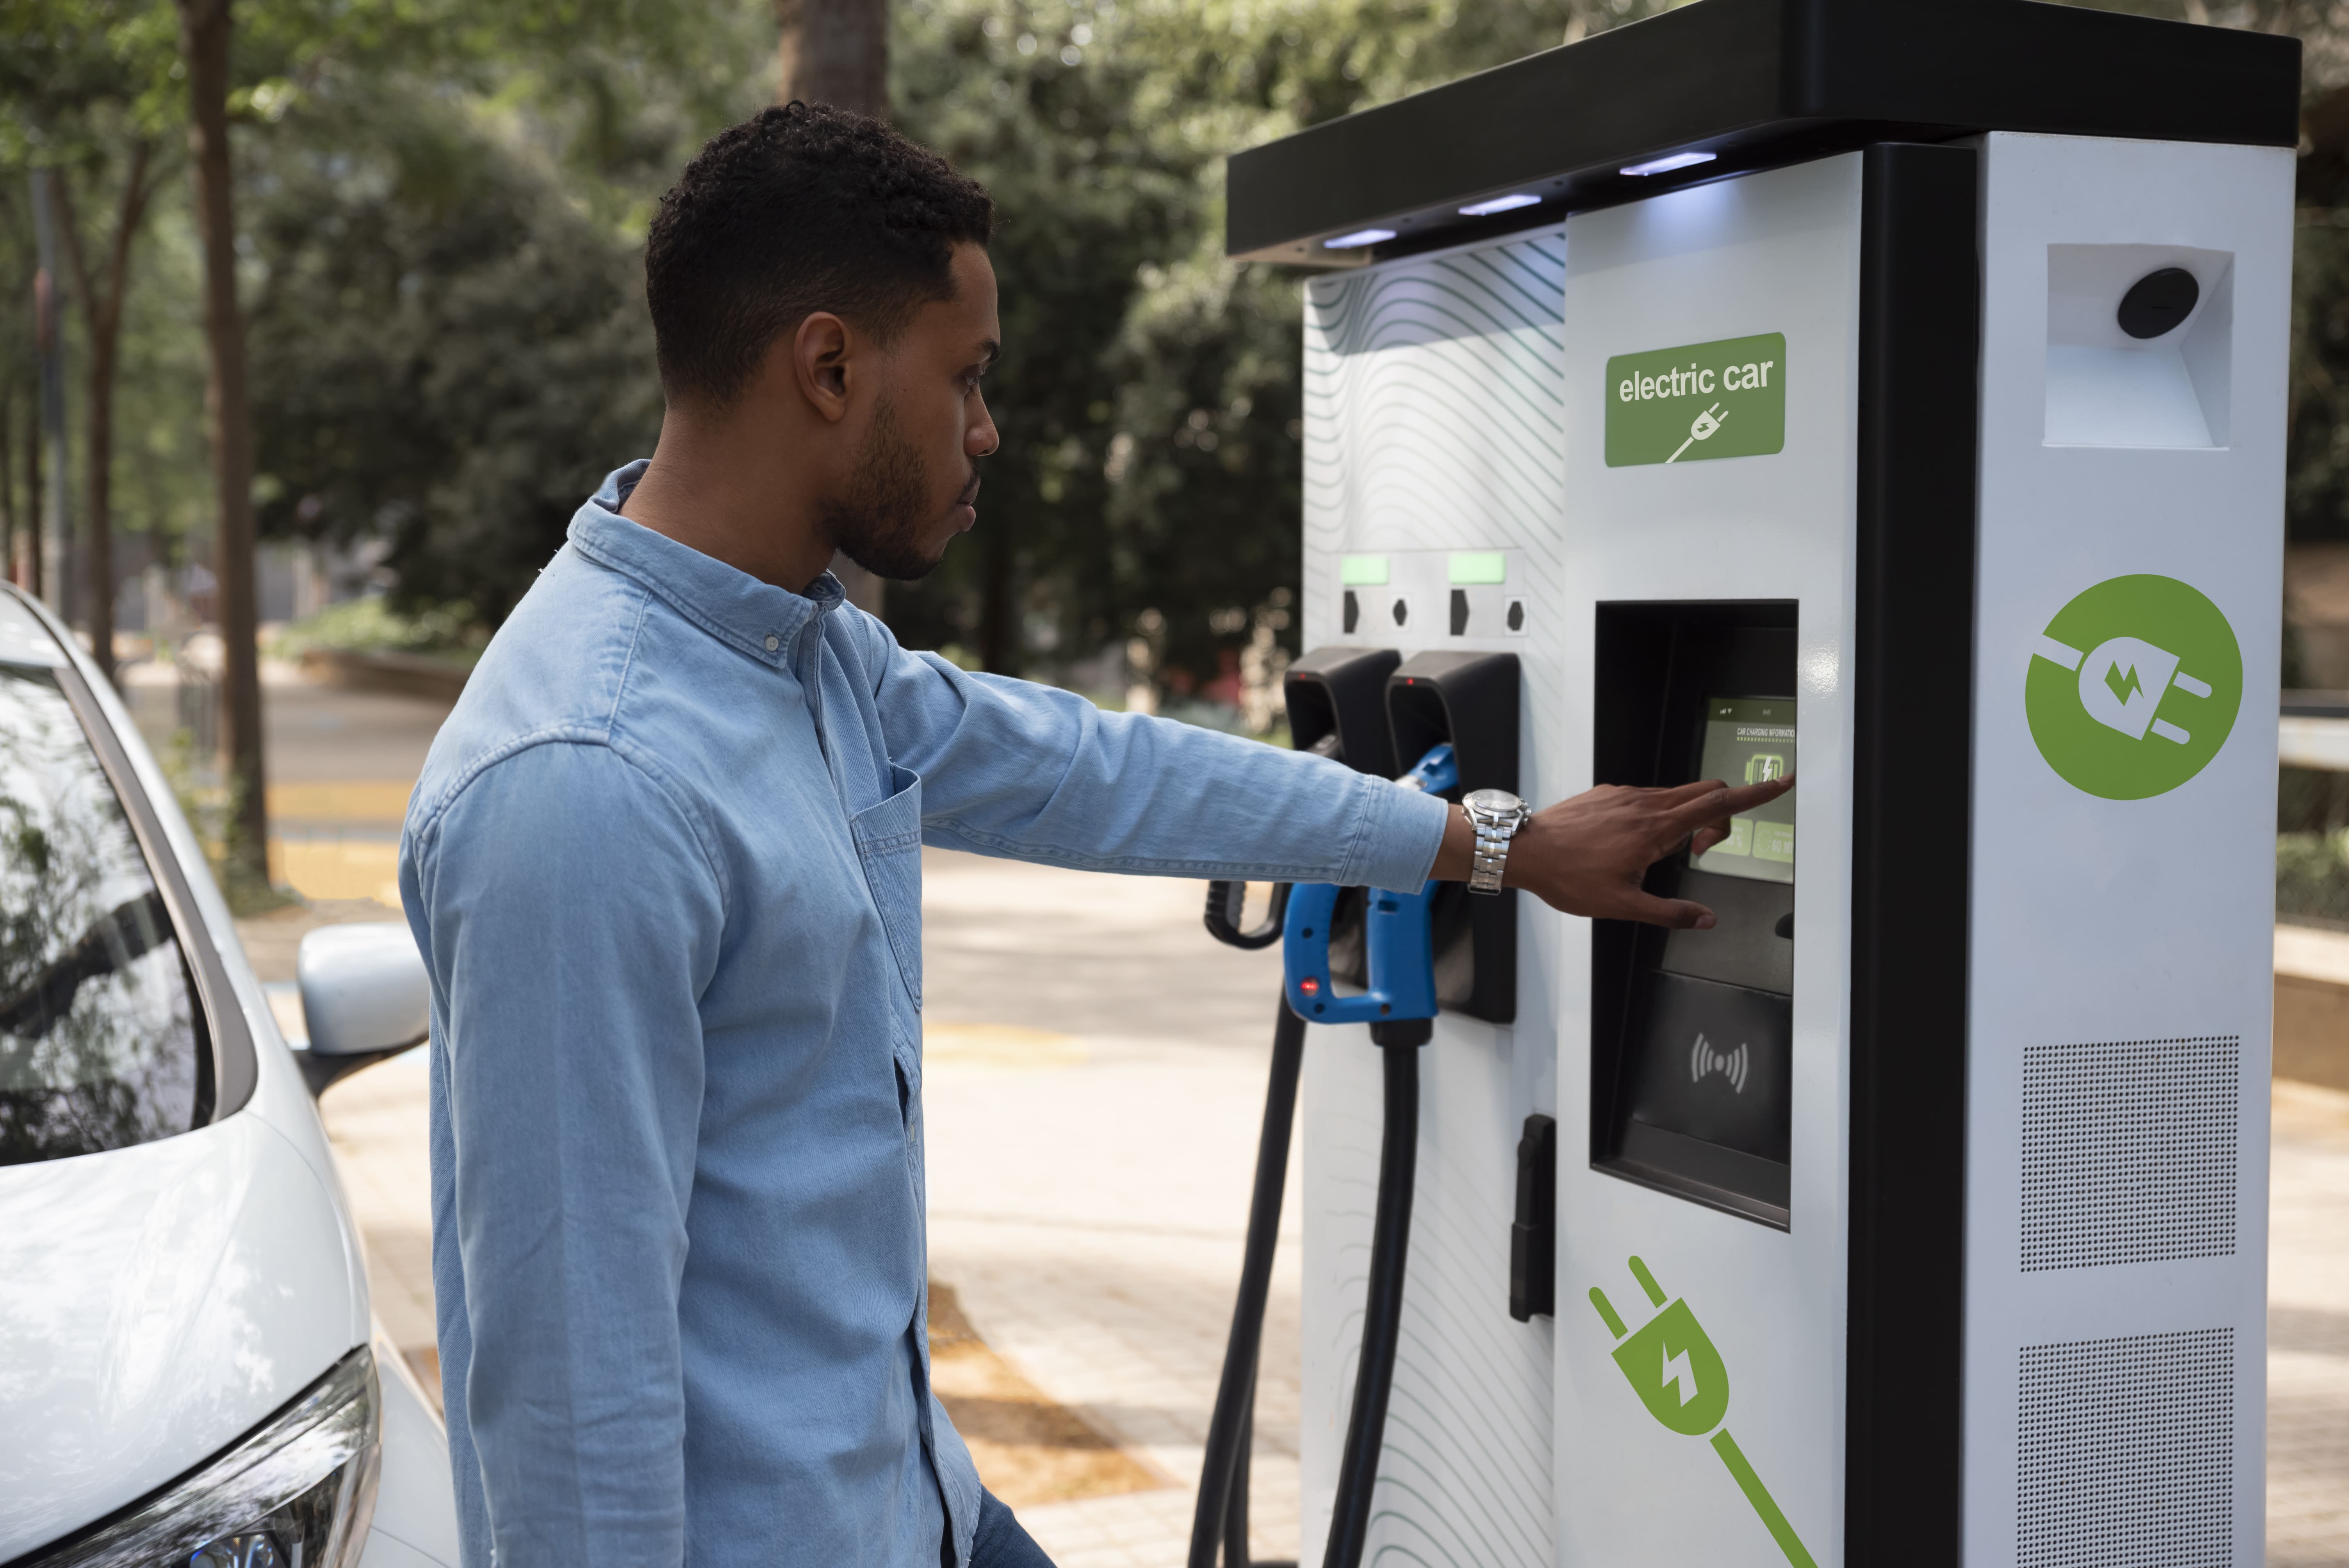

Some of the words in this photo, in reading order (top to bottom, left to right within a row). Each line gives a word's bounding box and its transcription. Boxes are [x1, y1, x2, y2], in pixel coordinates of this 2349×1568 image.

[1619, 363, 1715, 402] electric
[1723, 361, 1773, 391] car
[1747, 728, 1768, 736] CHARGING
